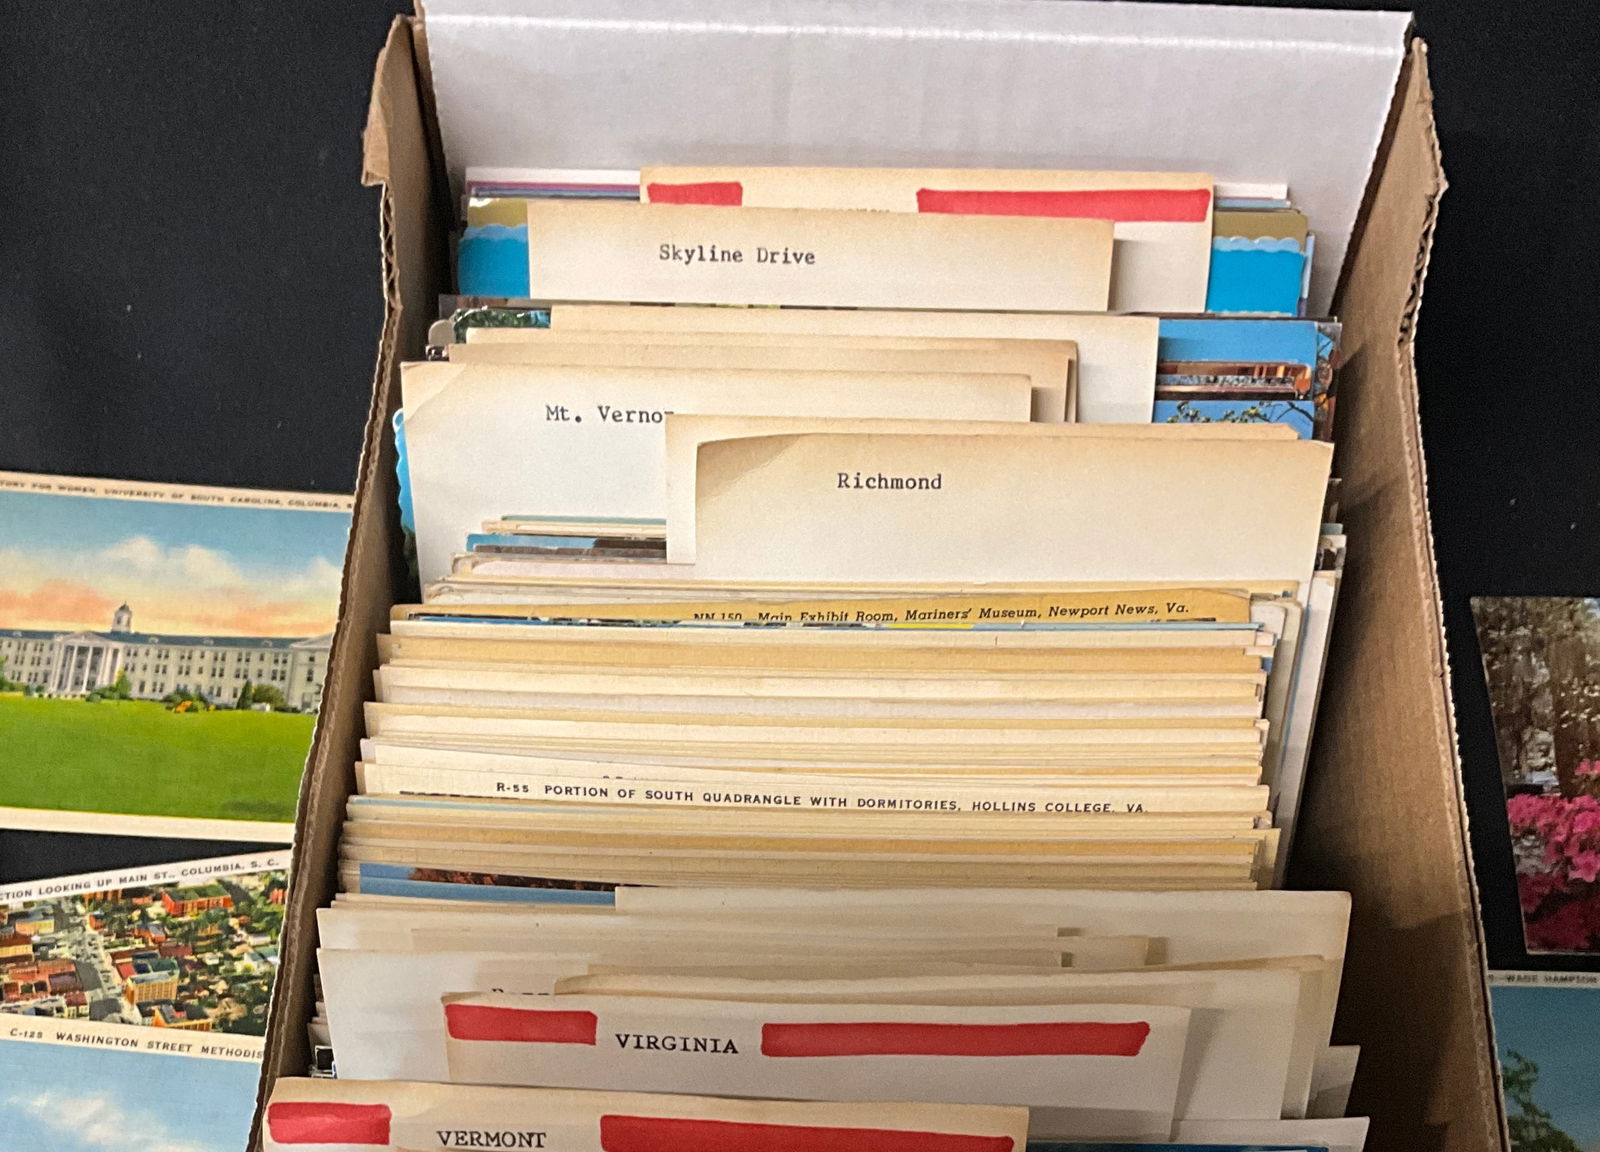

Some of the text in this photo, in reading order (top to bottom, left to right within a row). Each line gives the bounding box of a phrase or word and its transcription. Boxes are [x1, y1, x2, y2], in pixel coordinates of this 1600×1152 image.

[659, 244, 816, 266] Skyline Drive
[545, 404, 582, 423] Mt.
[837, 471, 942, 490] Richmond
[32, 482, 52, 491] FOR
[104, 487, 165, 499] UNIVERSITY
[191, 494, 224, 502] SOUTH
[758, 611, 793, 621] Main
[800, 610, 849, 622] Exhibit
[856, 610, 899, 622] Room,
[978, 607, 1042, 619] Museum,
[1049, 605, 1109, 618] Newport
[1115, 603, 1159, 615] News,
[1166, 602, 1189, 613] Va.
[496, 782, 530, 793] R-55
[545, 785, 609, 798] PORTION
[618, 788, 636, 799] OF
[645, 789, 694, 801] SOUTH
[703, 792, 801, 806] QUADRANGLE
[810, 797, 847, 808] WITH
[857, 798, 961, 811] DORMITORIES,
[972, 800, 1036, 812] HOLLINS
[40, 881, 91, 895] LOOKING
[97, 879, 112, 888] UP
[119, 873, 148, 884] MAIN
[251, 860, 262, 869] S.
[267, 858, 280, 867] C.
[10, 1027, 43, 1039] C-125
[56, 1031, 139, 1048] WASHINGTON
[147, 1040, 193, 1053] STREET
[615, 1033, 739, 1054] VIRGINIA
[436, 1130, 547, 1148] VERMONT
